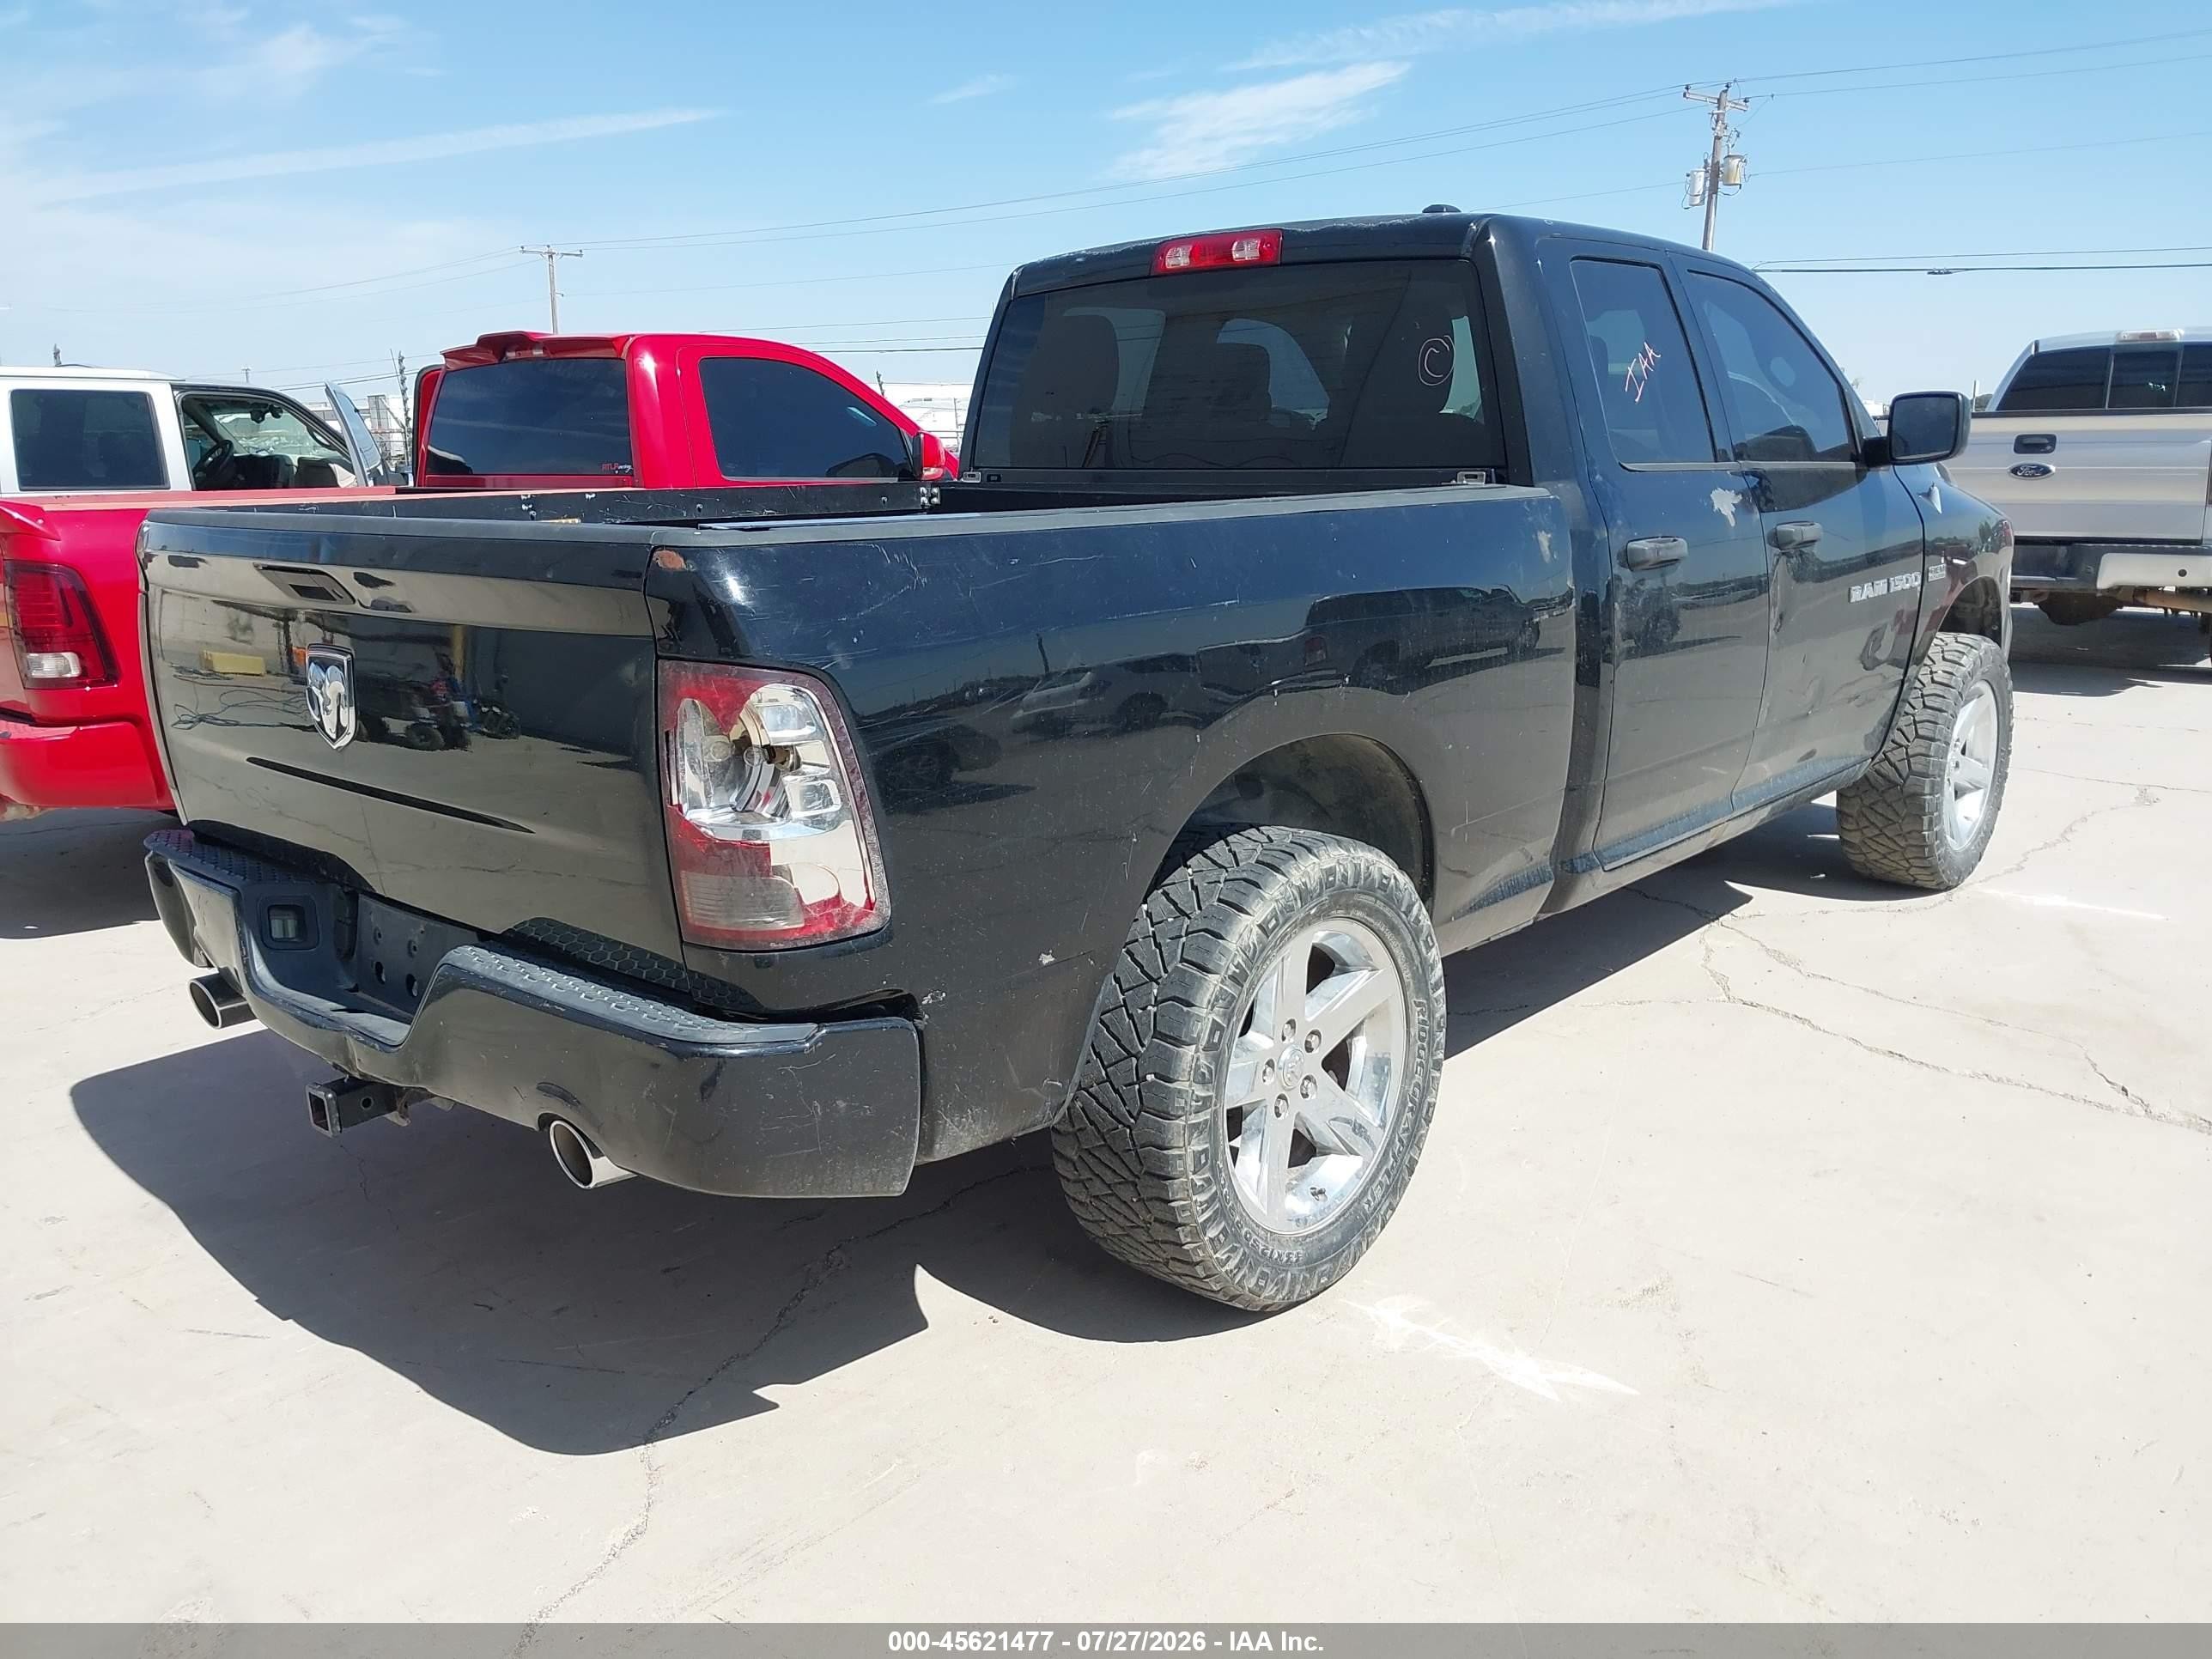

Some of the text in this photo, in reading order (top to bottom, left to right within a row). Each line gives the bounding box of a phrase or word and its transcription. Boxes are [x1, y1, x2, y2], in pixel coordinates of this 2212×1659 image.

[1624, 340, 1662, 404] IAA
[2017, 465, 2045, 476] Ford
[1849, 571, 1922, 603] RAM 1500
[1364, 999, 1430, 1211] RIDGE GRAPPLER
